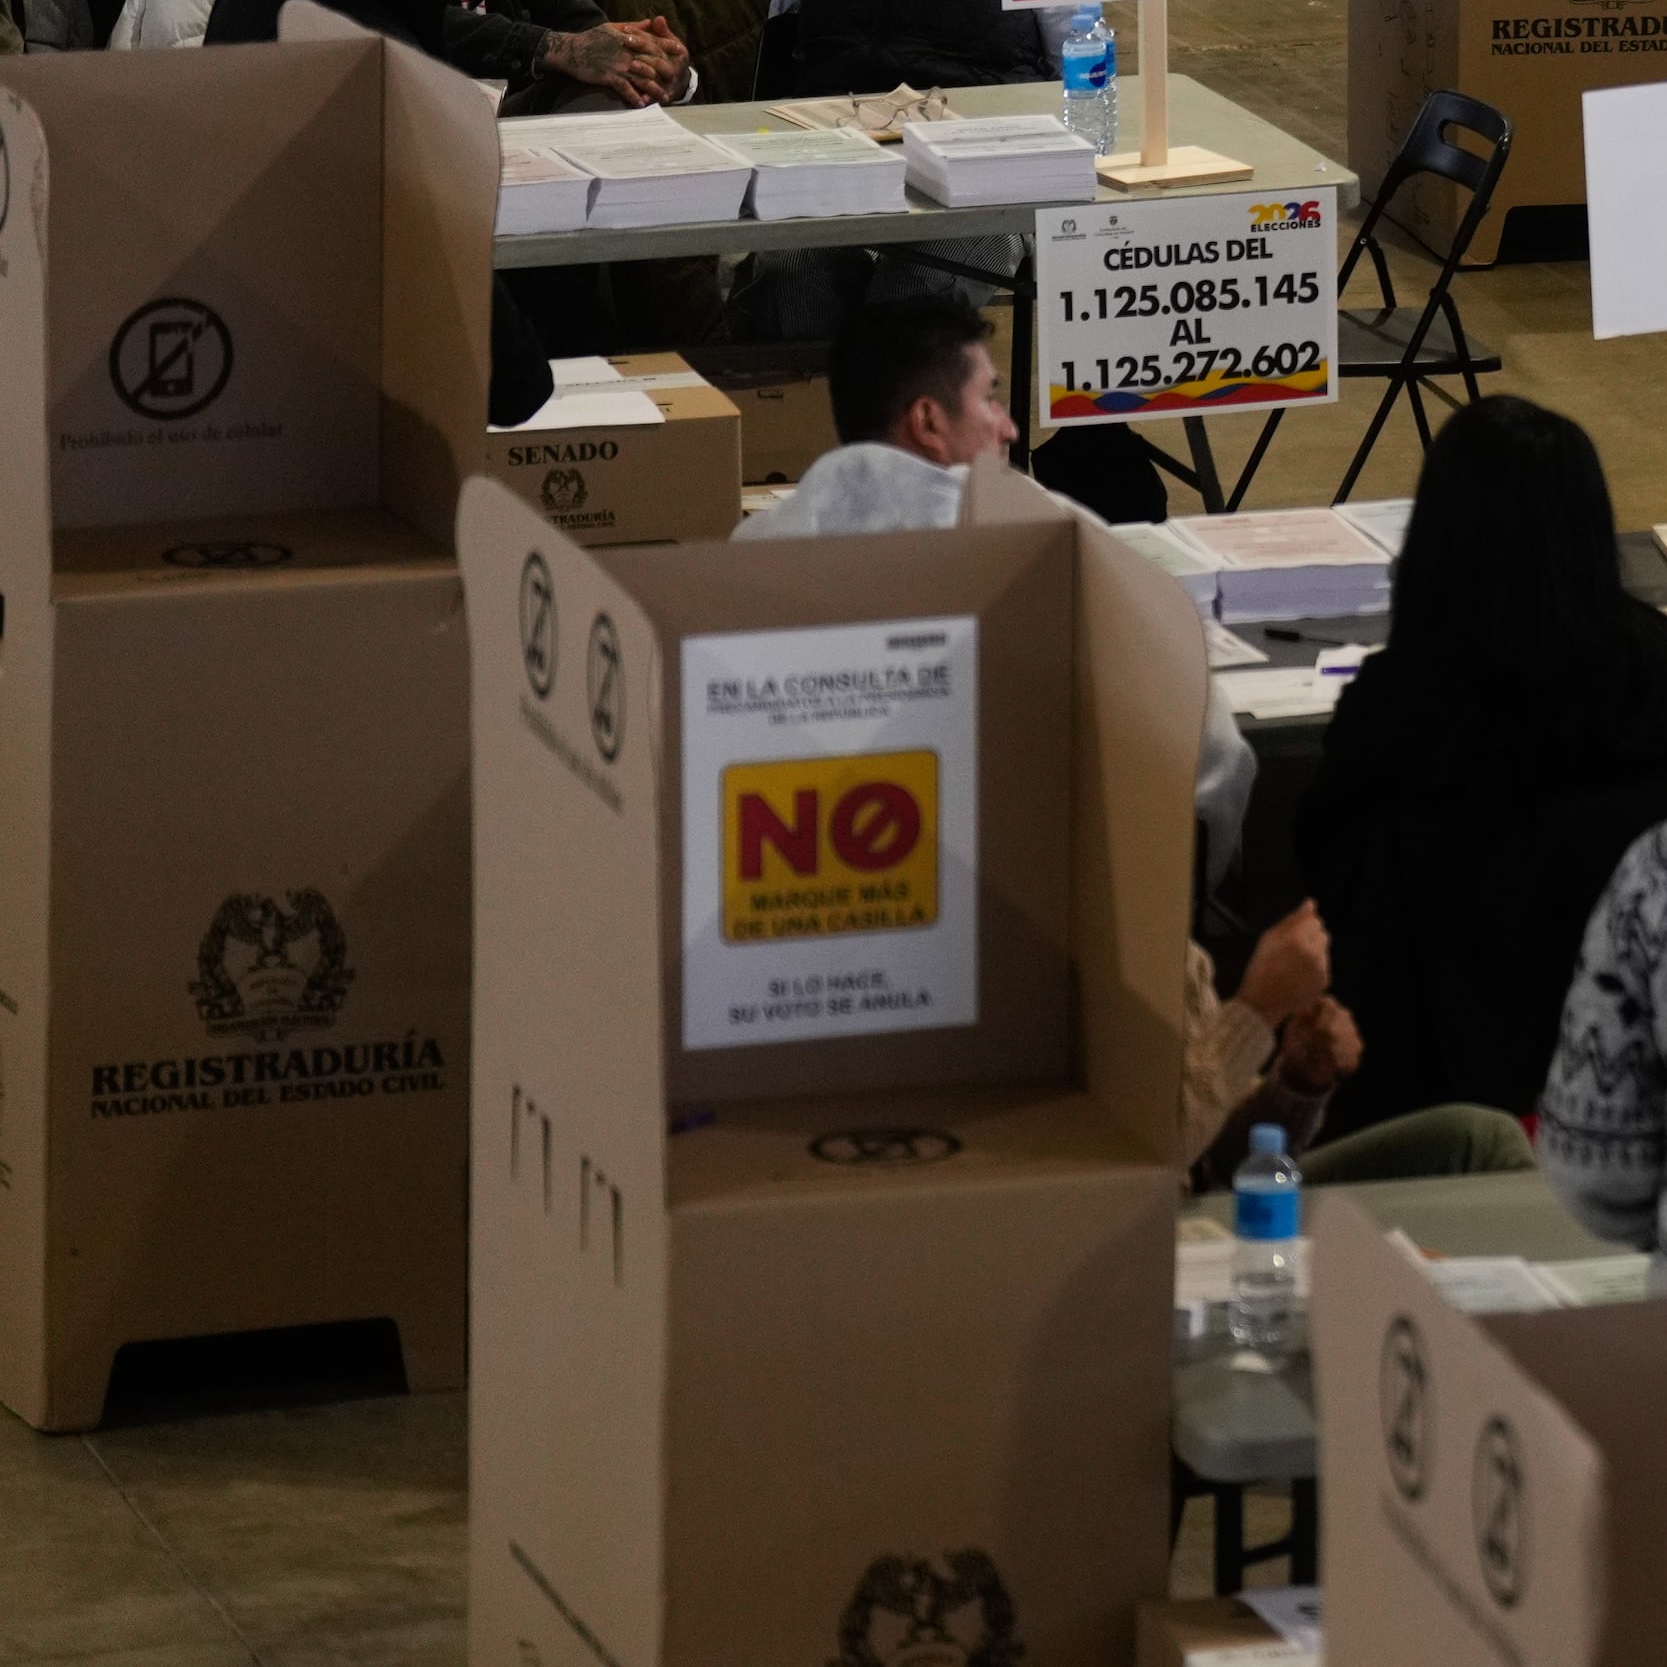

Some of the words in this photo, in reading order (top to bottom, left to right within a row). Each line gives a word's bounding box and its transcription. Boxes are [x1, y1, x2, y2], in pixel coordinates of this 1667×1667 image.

[1492, 42, 1573, 55] NACIONAL
[1581, 41, 1612, 52] DEL
[1249, 201, 1320, 224] 2026
[1251, 220, 1321, 232] ELECCIONES
[1104, 241, 1219, 271] CÉDULAS
[1226, 238, 1272, 261] DEL
[1060, 272, 1319, 321] 1.125.085.145
[1170, 318, 1210, 346] AL
[1062, 341, 1320, 391] 1.125.272.602
[508, 441, 618, 466] SENADO
[552, 510, 615, 524] TRADURÍA
[737, 777, 918, 880] NO
[91, 1028, 444, 1096] REGISTRADURÍA
[92, 1094, 213, 1119] NACIONAL
[223, 1087, 271, 1108] DEL
[280, 1077, 374, 1102] ESTADO
[382, 1073, 444, 1093] CIVIL
